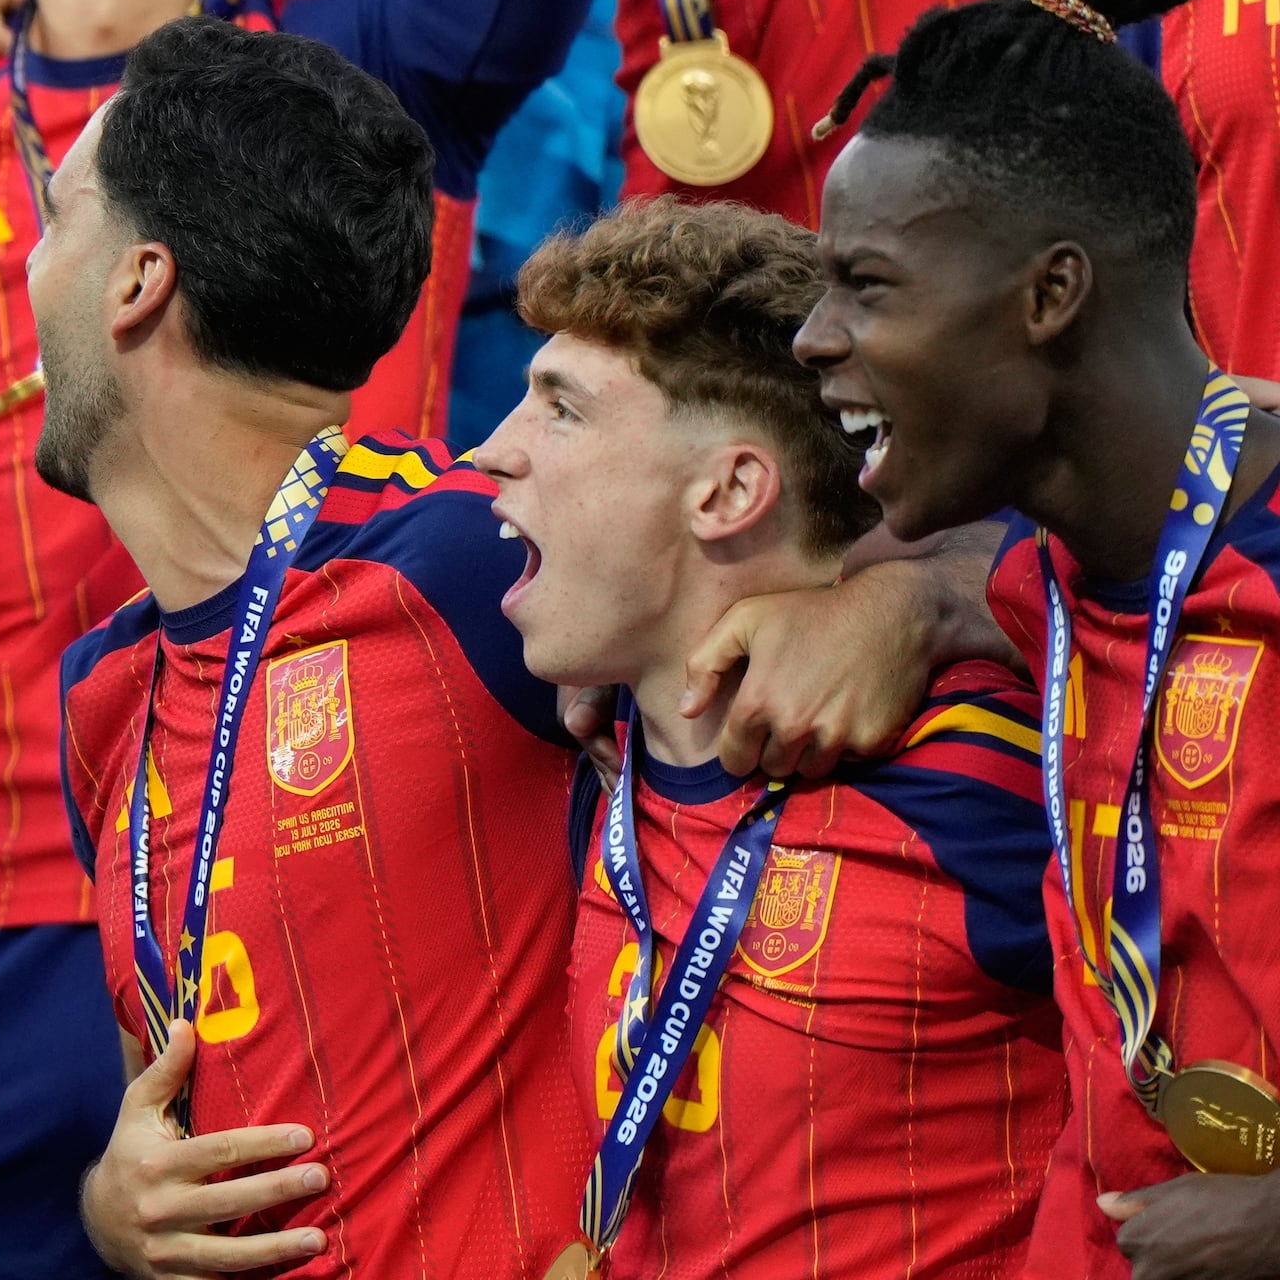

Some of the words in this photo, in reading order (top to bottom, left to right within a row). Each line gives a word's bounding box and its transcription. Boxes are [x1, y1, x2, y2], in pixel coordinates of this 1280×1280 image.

[240, 586, 269, 644] FIFA
[1048, 579, 1065, 677] 2026
[1153, 549, 1188, 651] 2026
[219, 649, 251, 747] WORLD
[1048, 681, 1063, 735] CUP
[210, 750, 227, 817] CUP
[277, 817, 297, 831] SPAIN
[311, 802, 355, 822] ARGENTINA
[1047, 736, 1063, 842] WORLD
[274, 846, 290, 858] NEW
[292, 841, 311, 854] YORK
[314, 836, 332, 848] NEW
[336, 826, 365, 842] JERSEY
[301, 826, 317, 838] JULY
[320, 819, 340, 833] 2026
[609, 774, 626, 872] WORLD
[1126, 795, 1147, 894] 2026
[194, 818, 220, 907] 2026
[717, 845, 751, 900] FIFA
[135, 881, 149, 938] FIFA
[620, 871, 646, 932] FIFA
[679, 905, 733, 1001] WORLD
[660, 1003, 690, 1055] CUP
[616, 1053, 668, 1147] 2026
